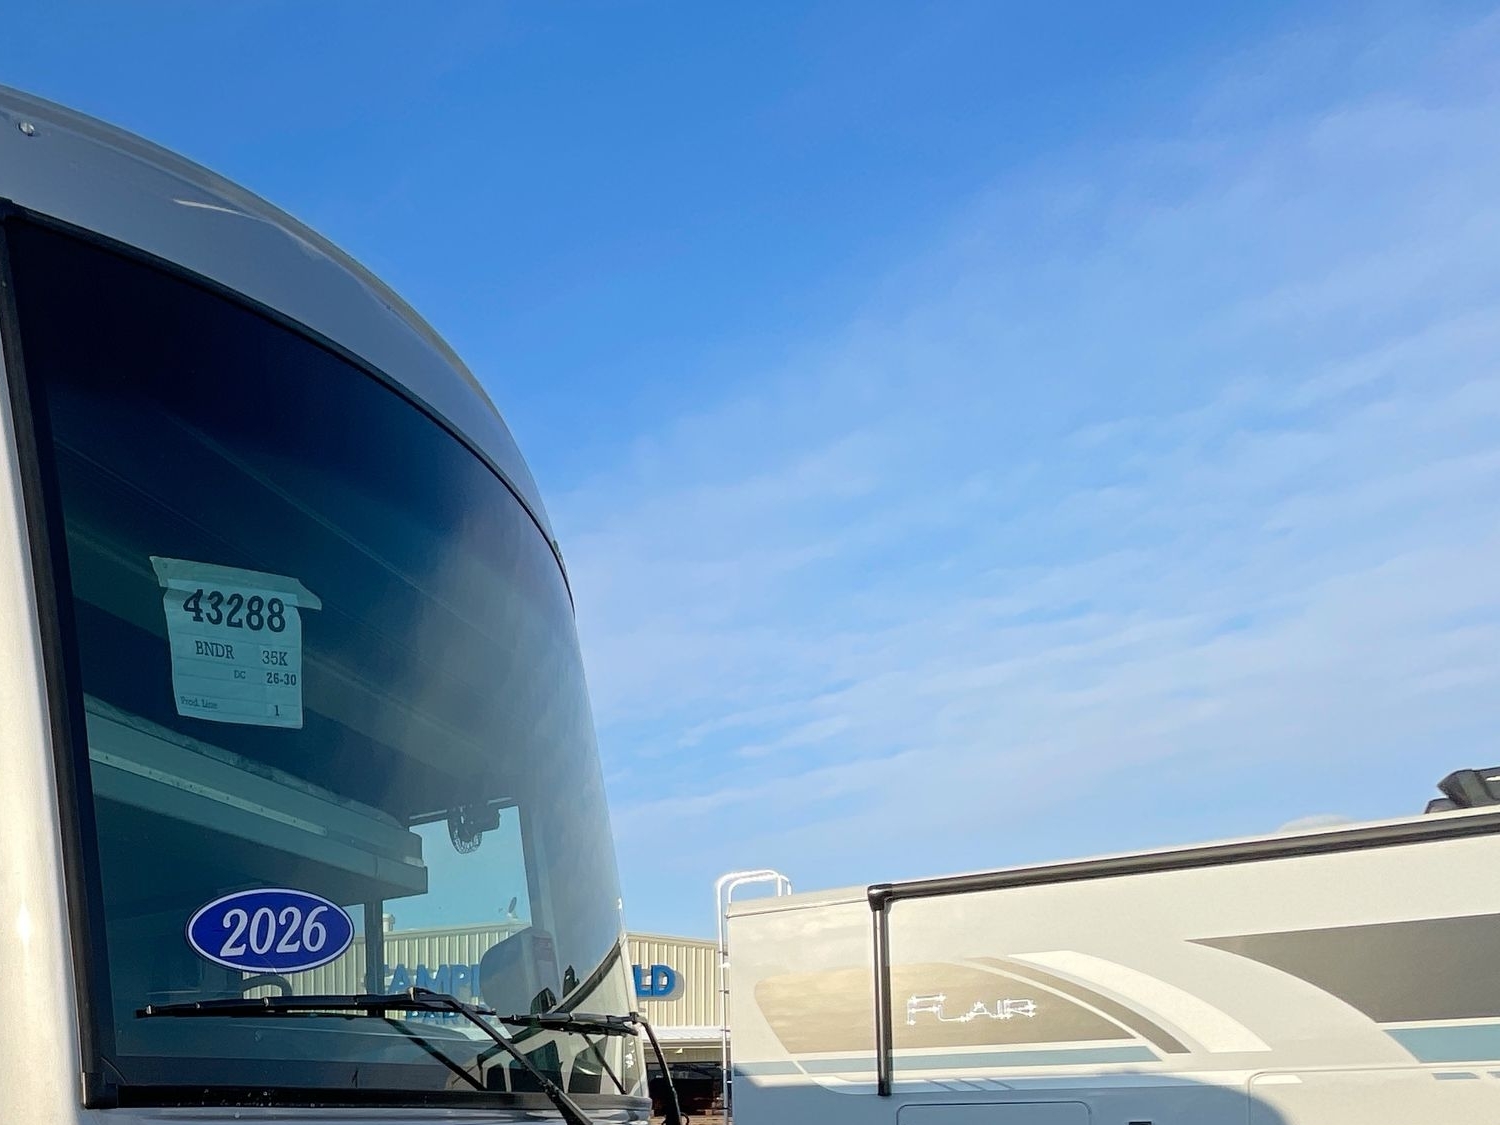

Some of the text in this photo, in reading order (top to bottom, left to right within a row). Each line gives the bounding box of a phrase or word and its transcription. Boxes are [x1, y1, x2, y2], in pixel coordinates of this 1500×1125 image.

[183, 588, 286, 633] 43288
[195, 640, 288, 667] BNDR 35K
[266, 672, 297, 686] 26-30
[274, 704, 280, 716] 1
[219, 904, 328, 958] 2026
[384, 963, 481, 999] AMPI
[906, 993, 1037, 1026] FLAIR
